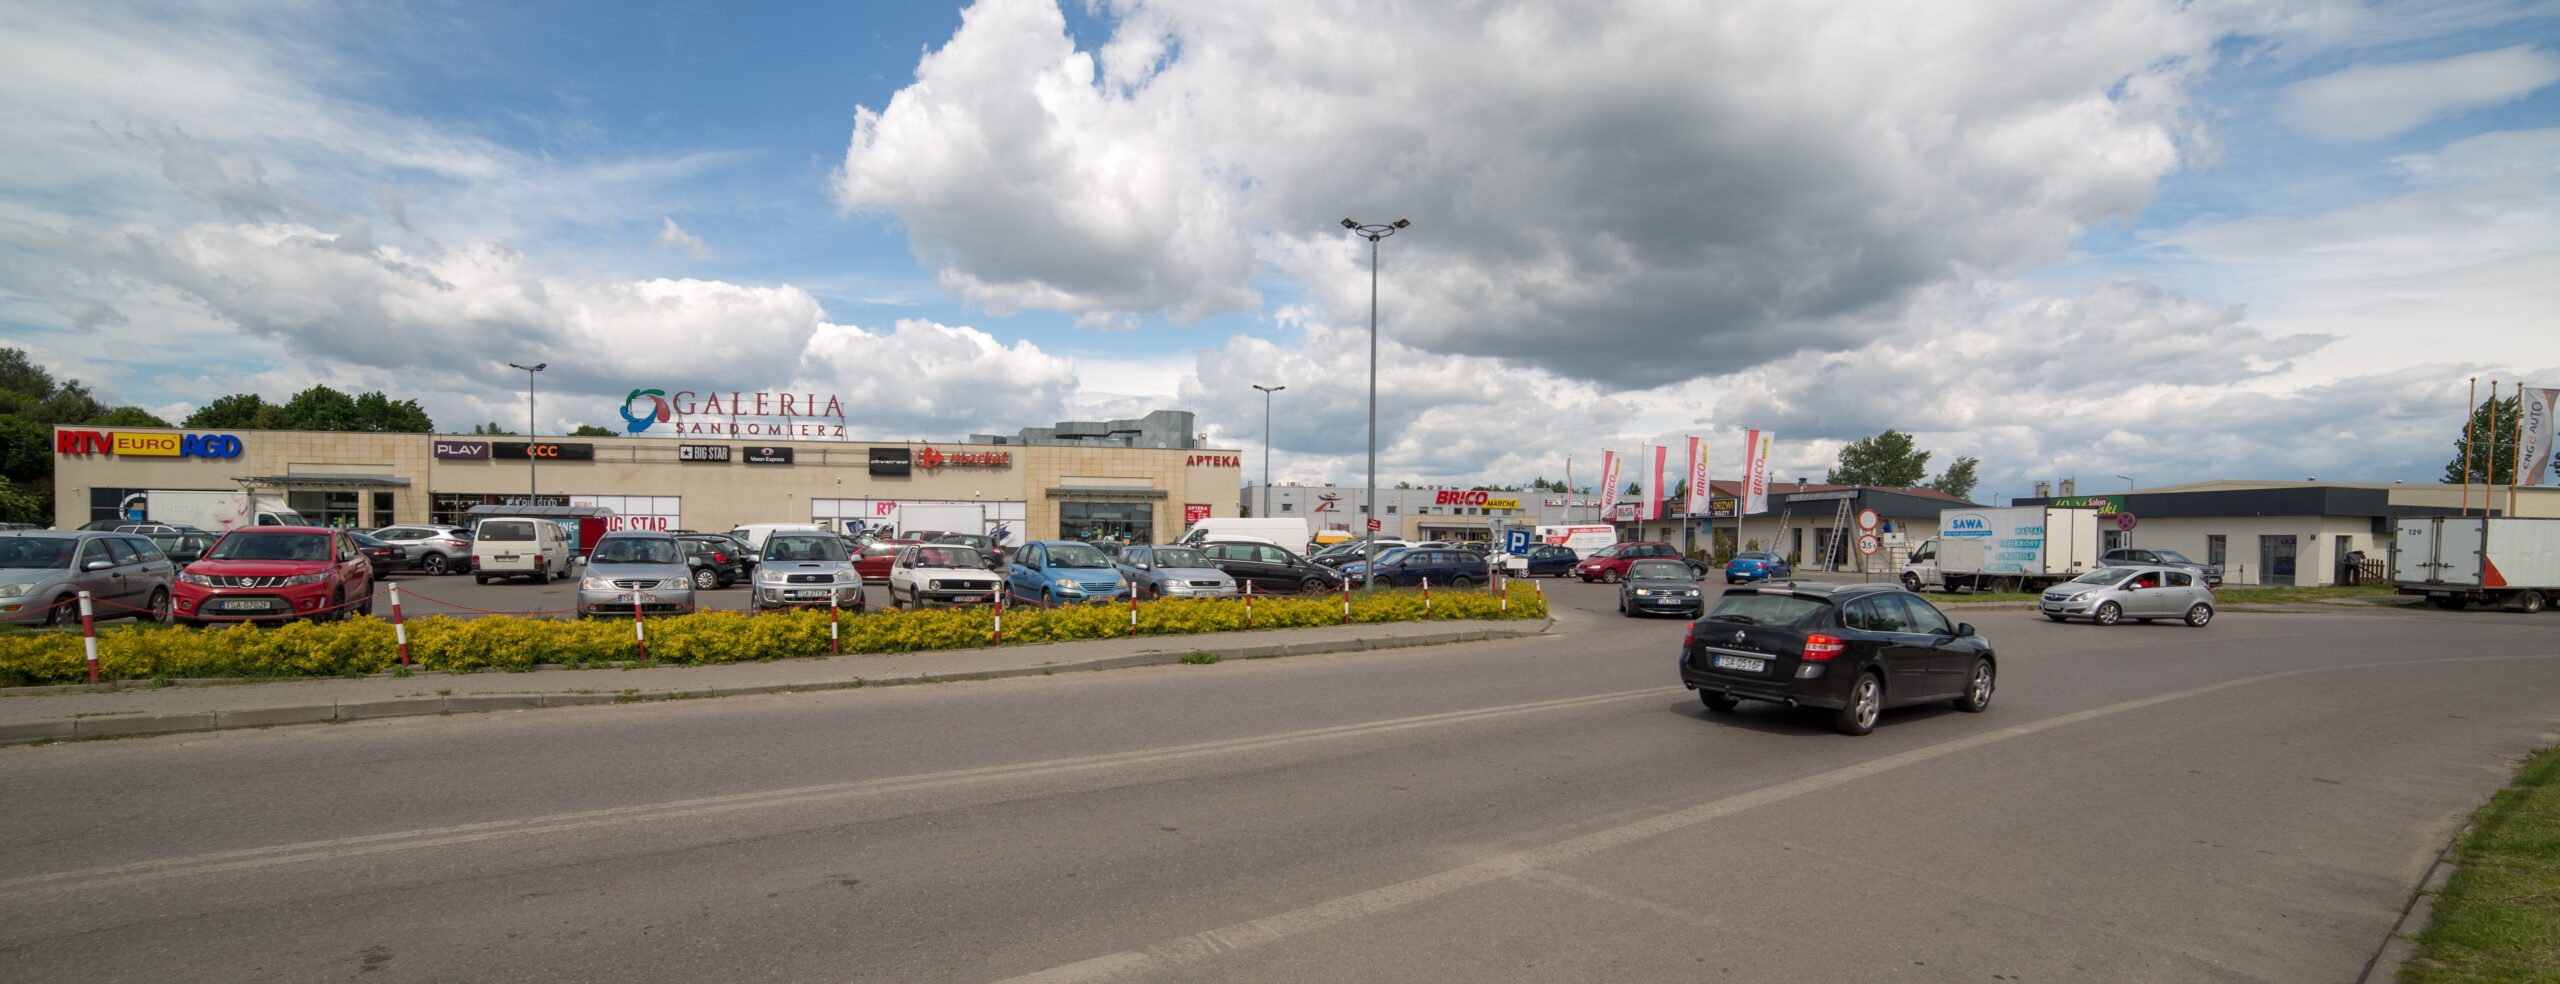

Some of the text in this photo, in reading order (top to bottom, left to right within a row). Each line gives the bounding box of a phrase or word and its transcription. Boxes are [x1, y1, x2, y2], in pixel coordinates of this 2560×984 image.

[672, 391, 845, 418] GALERIA
[676, 422, 843, 436] SANDOMIERZ
[57, 430, 242, 459] RTV EURO AGD
[437, 445, 482, 455] PLAY
[526, 445, 558, 457] CCC
[694, 446, 728, 460] BIG STAR
[949, 451, 1009, 465] market
[1186, 455, 1240, 467] APTEKA
[1697, 463, 1706, 497] BRICO
[1754, 458, 1764, 496] BRICO
[1605, 474, 1616, 505] BRICO
[1435, 490, 1488, 506] BRICO
[1712, 500, 1734, 510] DRZWI
[2088, 498, 2106, 506] Salon
[1952, 519, 1983, 529] SAWA
[225, 600, 241, 609] TSA
[1721, 656, 1735, 666] TSA
